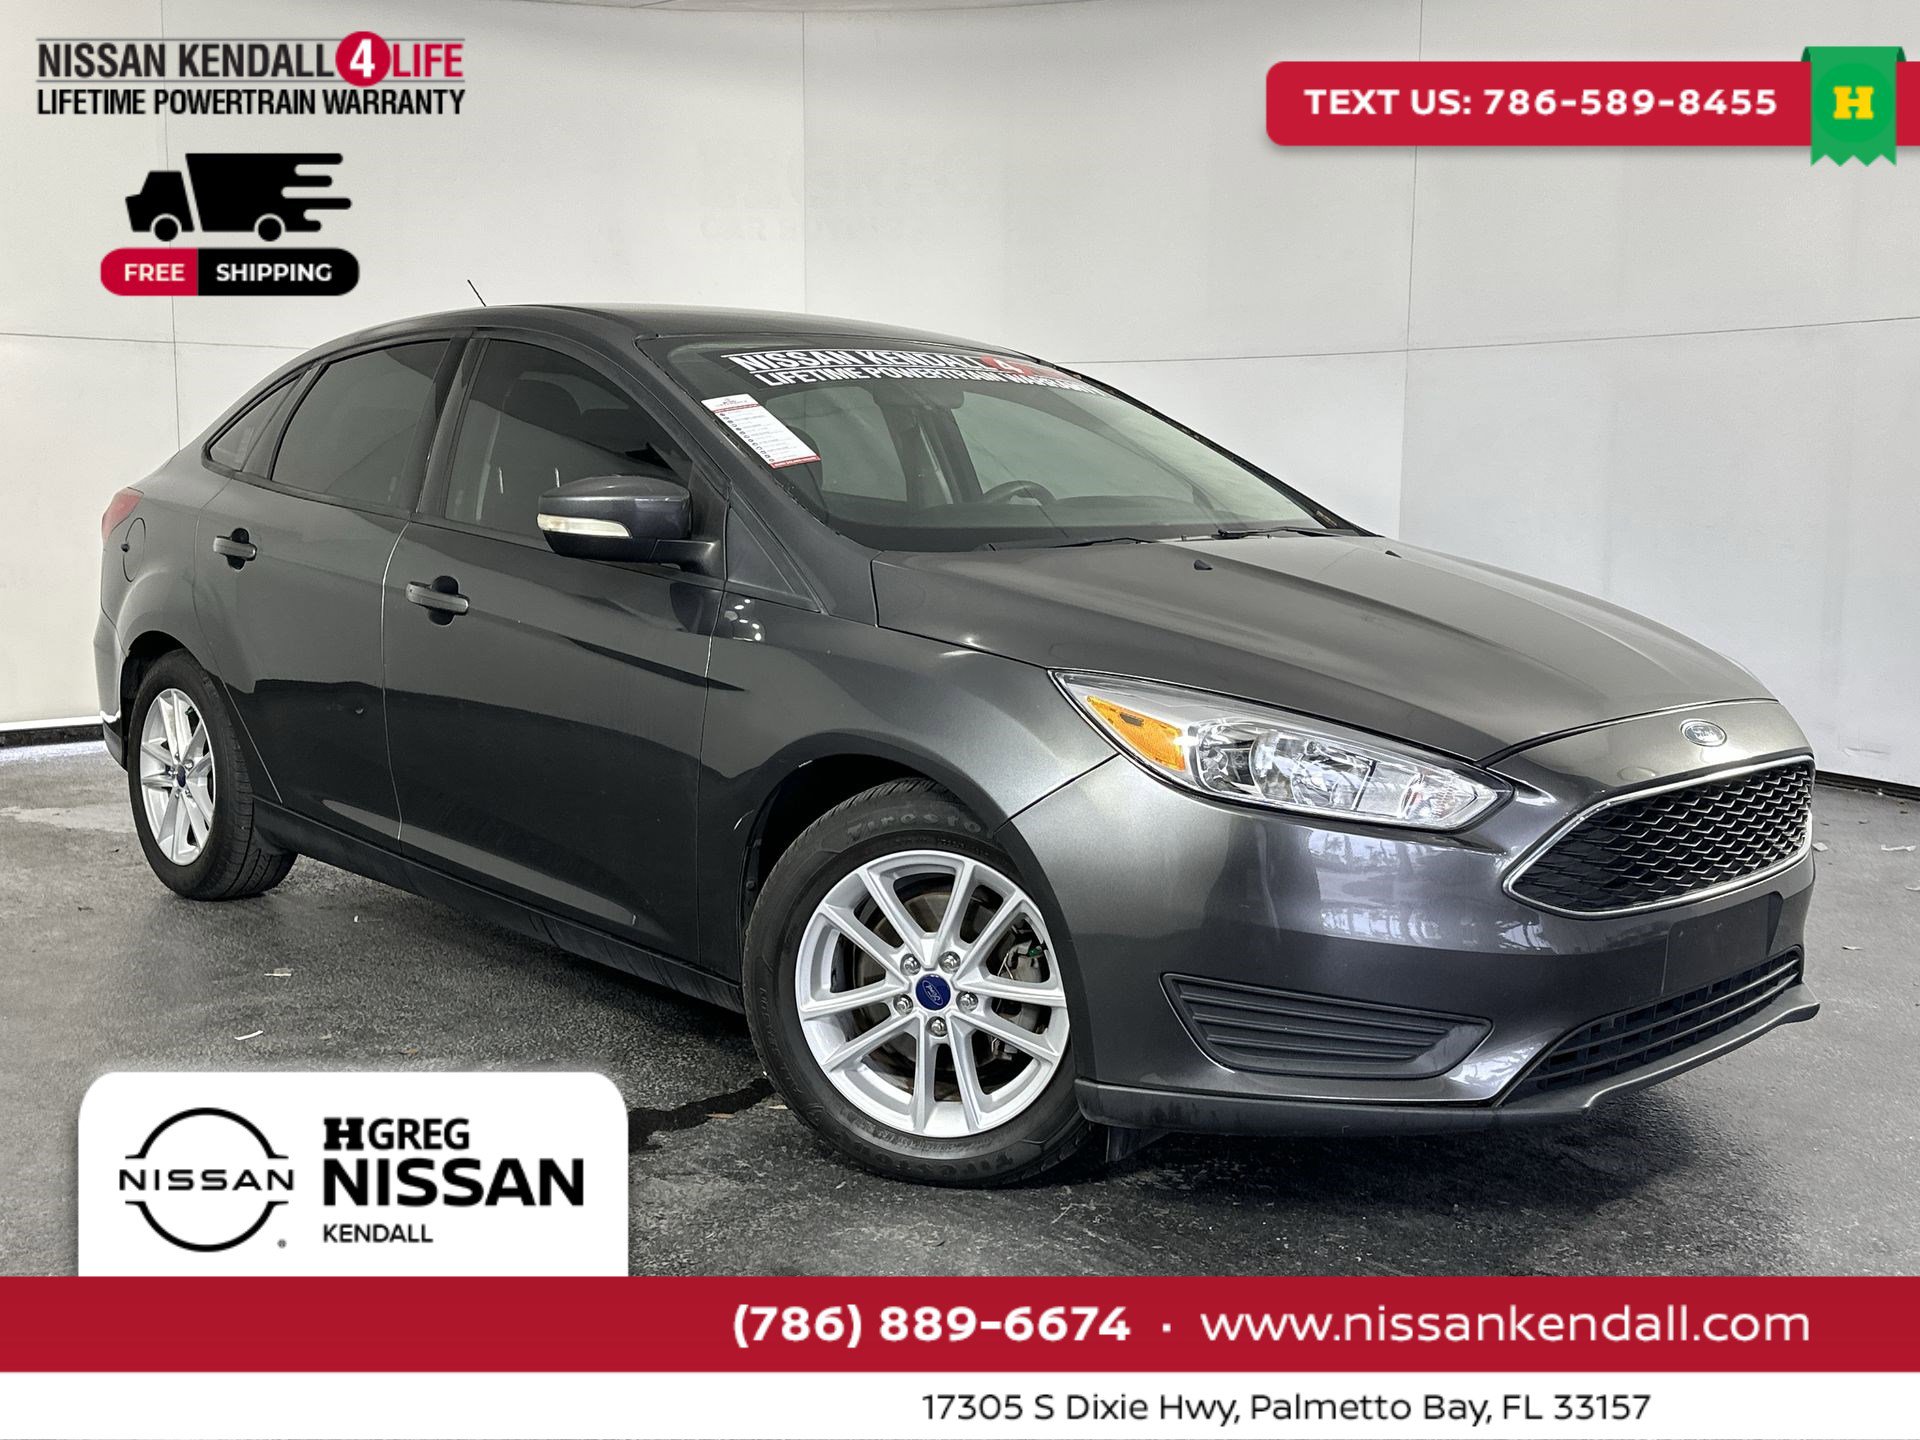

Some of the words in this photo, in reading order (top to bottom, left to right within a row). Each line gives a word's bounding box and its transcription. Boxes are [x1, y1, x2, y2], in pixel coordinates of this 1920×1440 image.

[728, 350, 865, 372] NISSAN
[854, 351, 993, 369] KENDALL
[754, 367, 871, 387] LIFETIME
[866, 366, 1009, 383] POWERTRAIN
